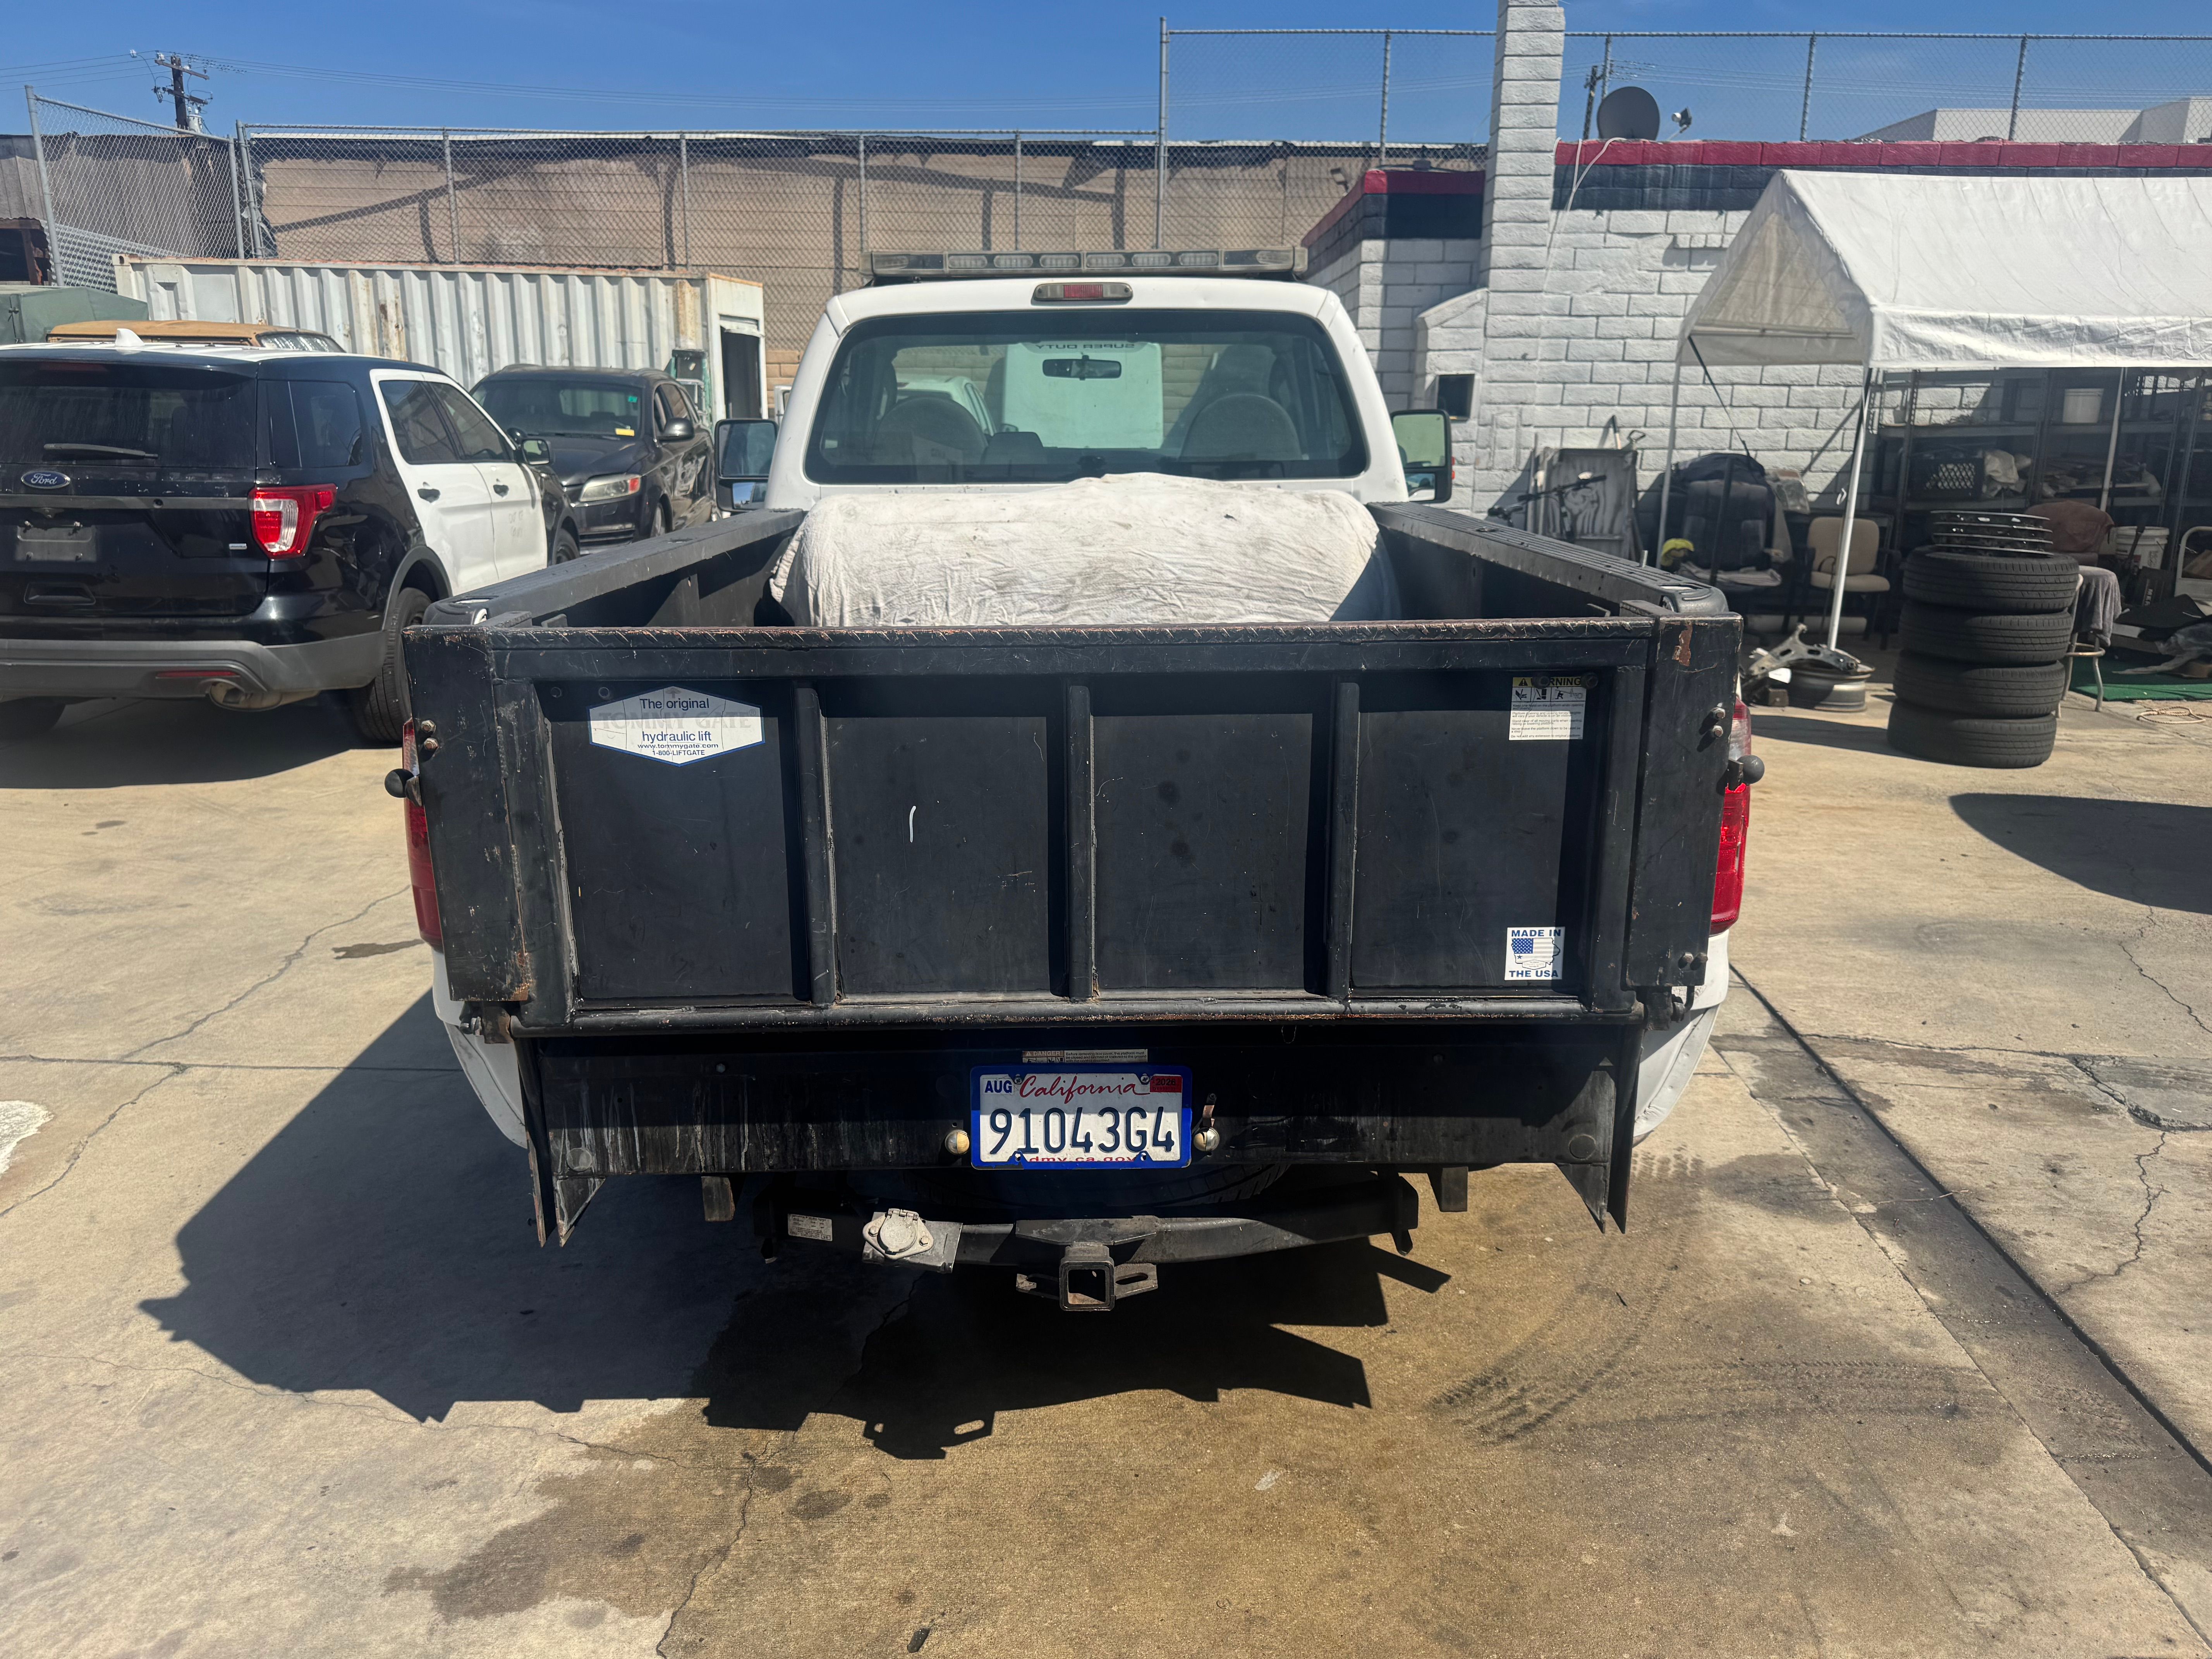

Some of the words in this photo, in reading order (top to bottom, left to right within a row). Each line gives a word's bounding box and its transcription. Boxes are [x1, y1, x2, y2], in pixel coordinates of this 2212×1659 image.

[31, 473, 58, 484] Ford
[1531, 677, 1581, 686] RNING
[640, 699, 662, 709] The
[666, 698, 709, 711] original
[599, 713, 688, 729] TOMMY
[642, 731, 696, 743] hydraulic
[699, 731, 711, 741] lift
[985, 1080, 1012, 1094] AUG
[1019, 1075, 1150, 1104] California
[990, 1106, 1175, 1154] 91043G4
